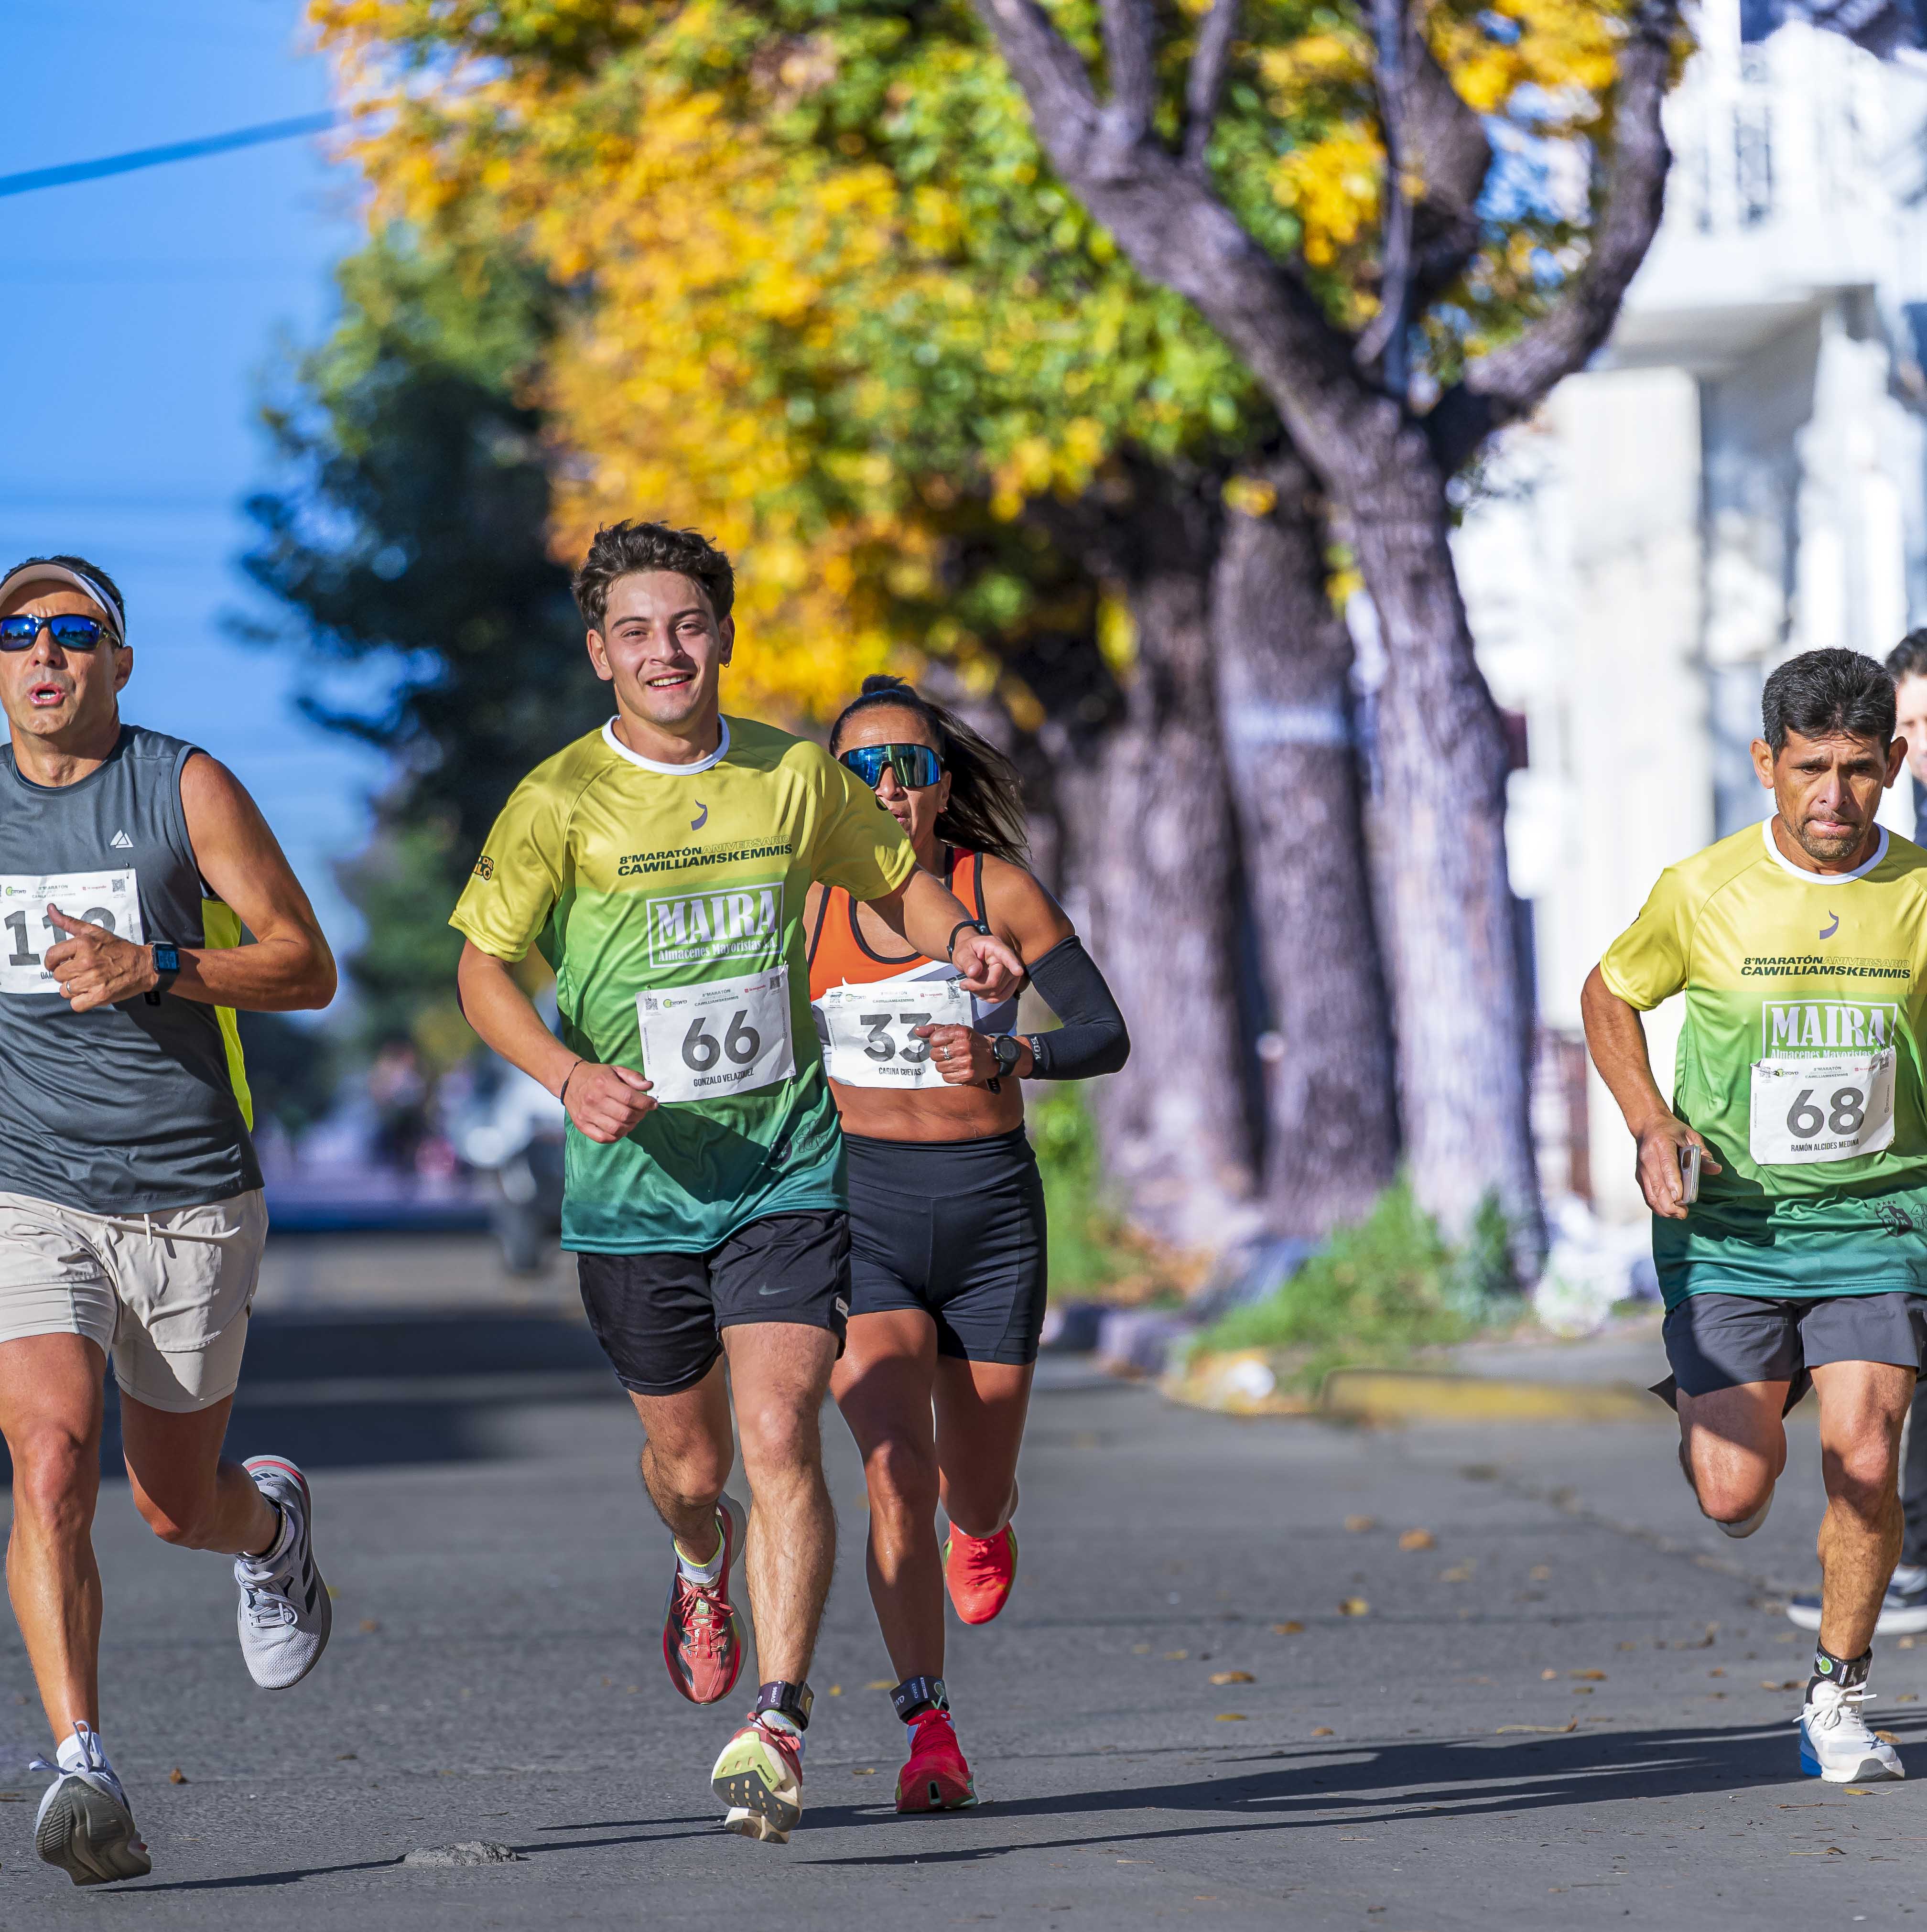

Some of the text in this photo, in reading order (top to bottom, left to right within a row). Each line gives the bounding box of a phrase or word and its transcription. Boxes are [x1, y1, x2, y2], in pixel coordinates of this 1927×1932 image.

[617, 843, 792, 876] CAWILLIAMSKEMMIS
[656, 891, 776, 947] MAIRA
[658, 947, 710, 961] Almacenes
[712, 939, 761, 956] Mayoristas
[1741, 966, 1911, 979] CAWILLIAMSKEMMIS
[682, 1009, 760, 1072] 66
[860, 1013, 932, 1063] 33
[1771, 1006, 1885, 1047] MAIRA
[693, 1068, 754, 1087] GONZALO VELAZQUEZ
[878, 1068, 921, 1076] CARINA CUEVAS
[1786, 1087, 1864, 1138] 68
[1791, 1138, 1859, 1152] RAMÓN ALCIDES MEDINA
